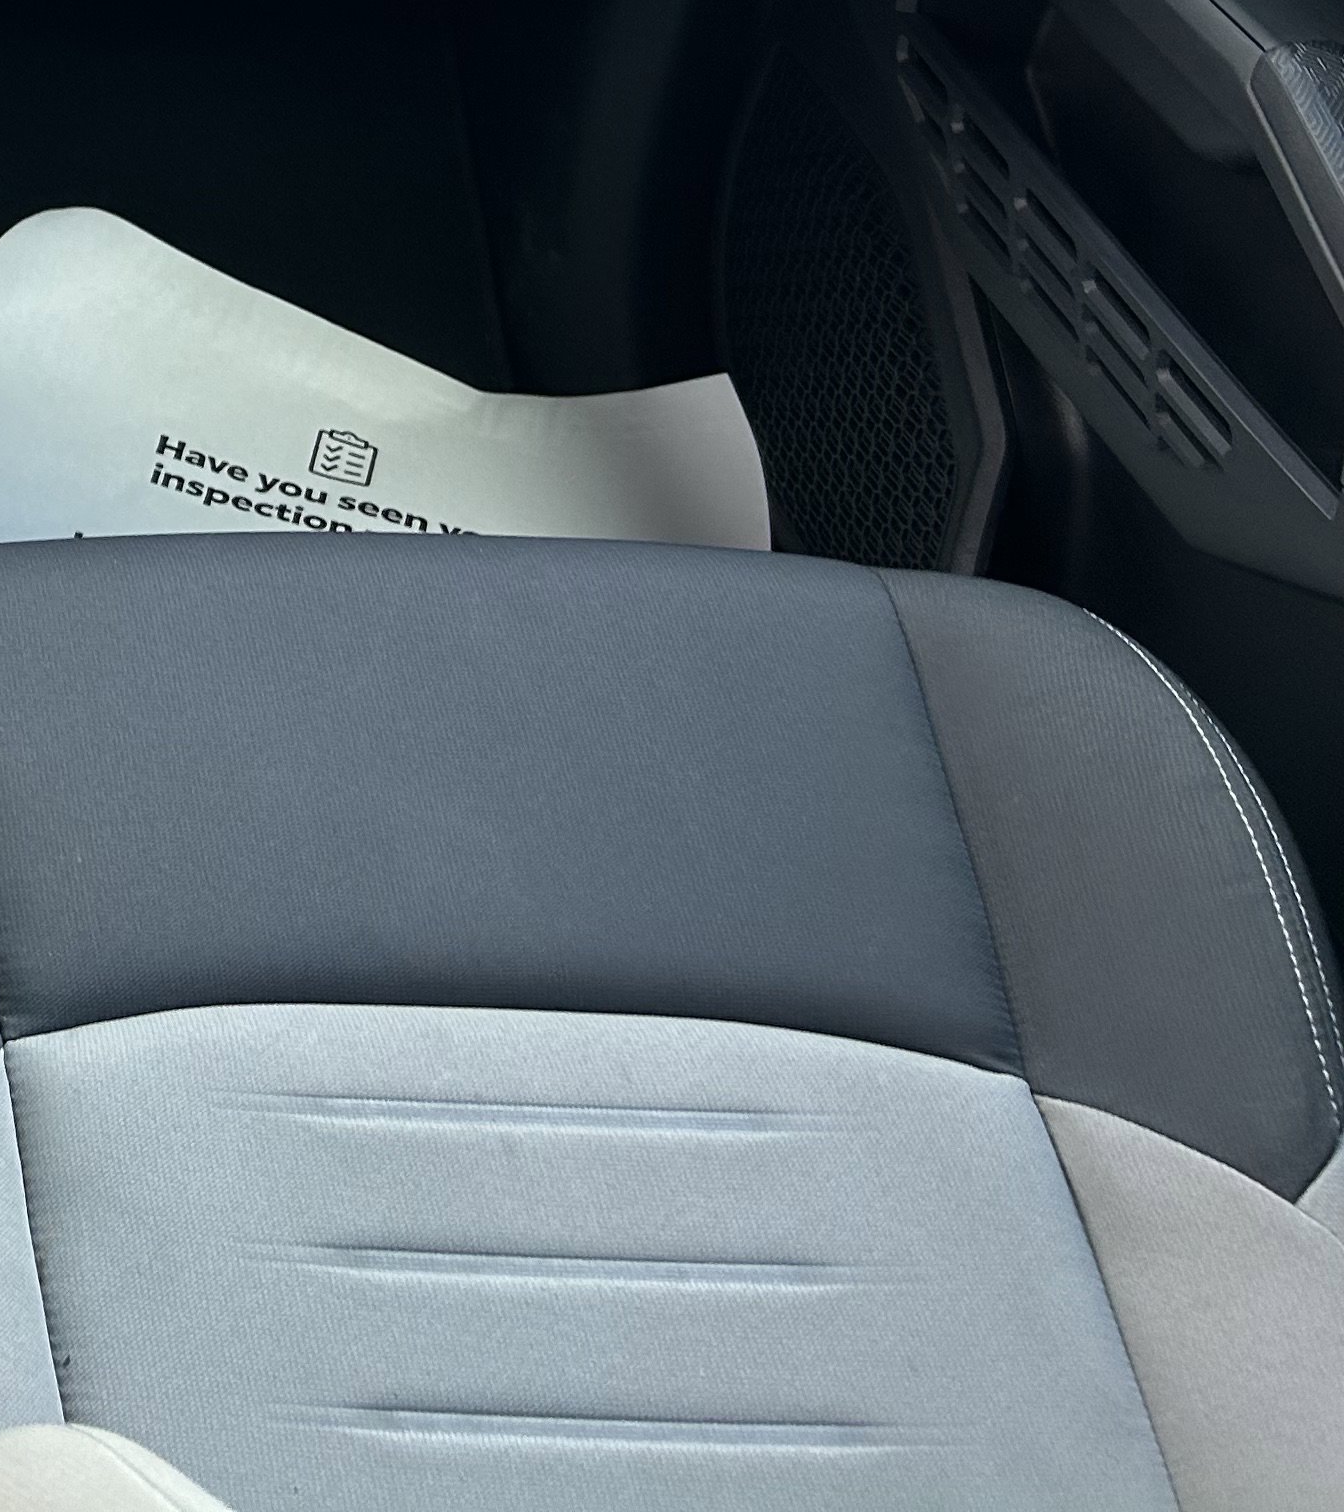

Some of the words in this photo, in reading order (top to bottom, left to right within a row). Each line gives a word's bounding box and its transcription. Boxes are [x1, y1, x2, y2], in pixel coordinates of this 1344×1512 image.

[149, 464, 353, 533] inspection
[155, 434, 248, 482] Have
[255, 471, 328, 505] you
[337, 494, 429, 534] seen
